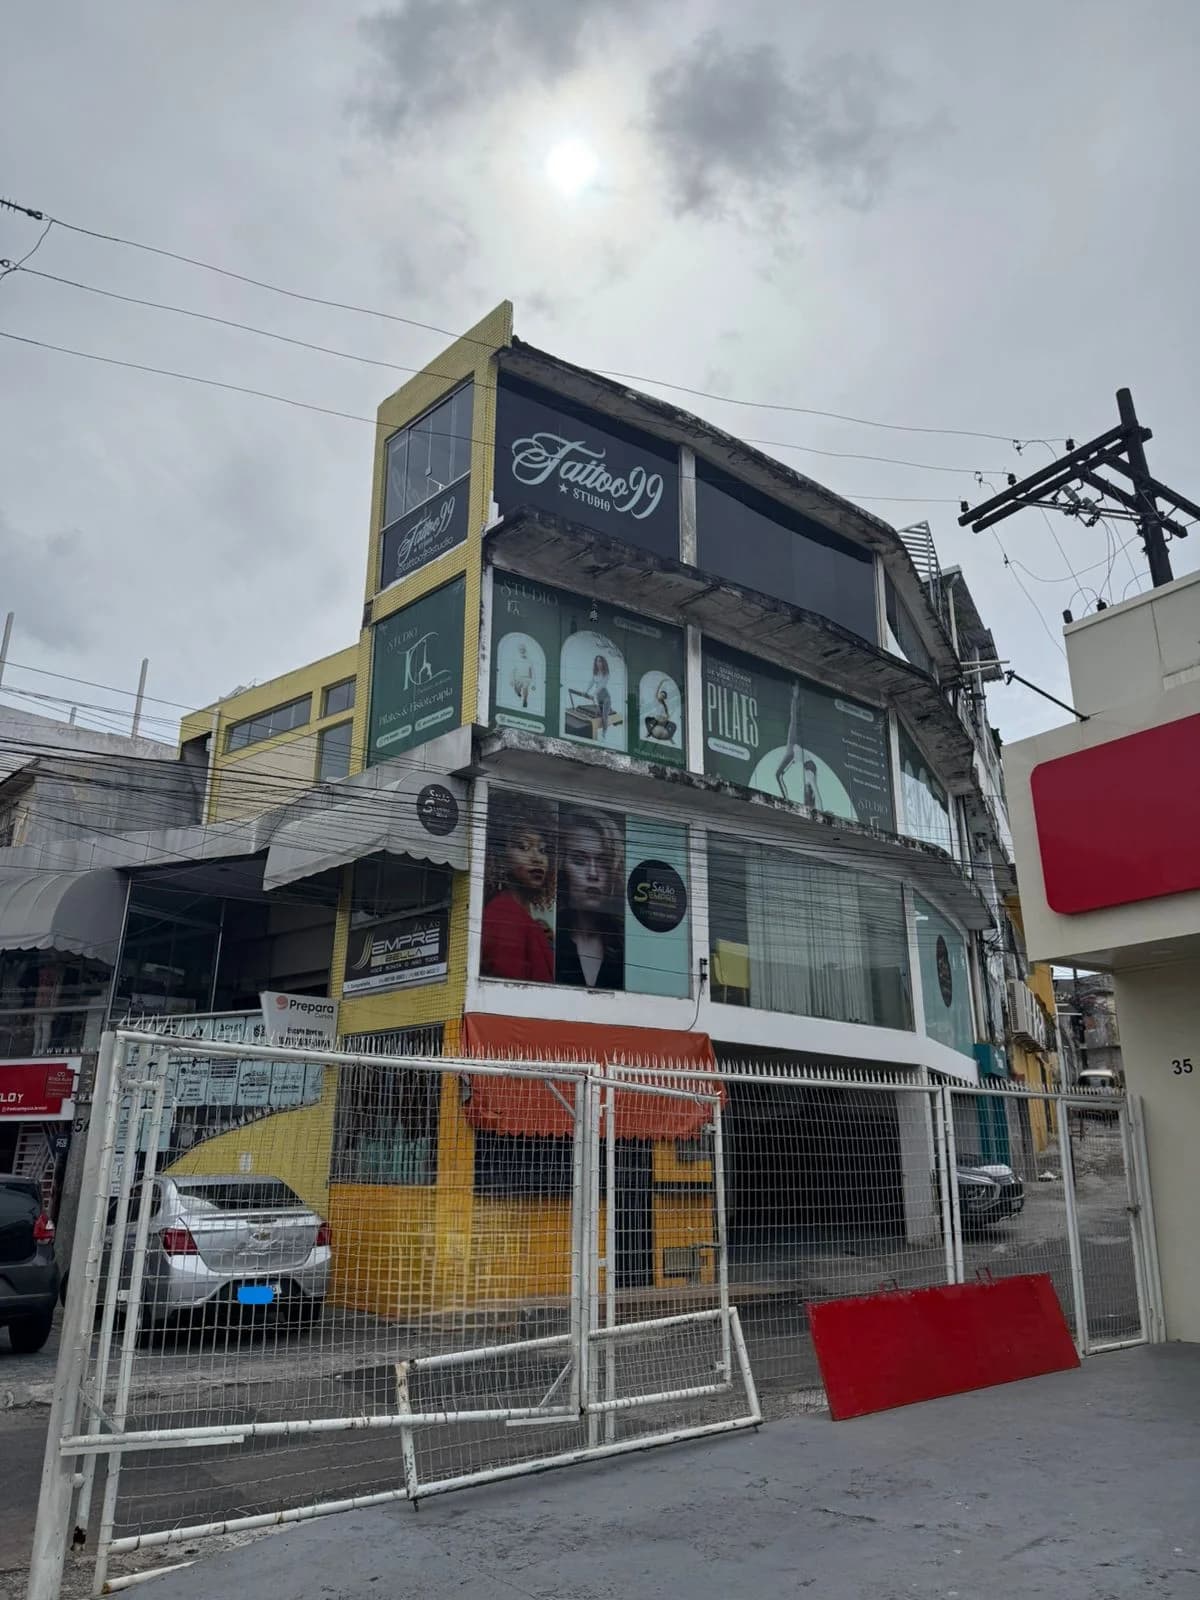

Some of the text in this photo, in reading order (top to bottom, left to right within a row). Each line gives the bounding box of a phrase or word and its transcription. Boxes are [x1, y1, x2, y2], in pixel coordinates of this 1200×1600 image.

[573, 487, 611, 512] STUDIO
[500, 580, 559, 607] STUDIO
[385, 947, 423, 962] BELLA
[289, 999, 334, 1014] Prepara
[1171, 1058, 1193, 1075] 35
